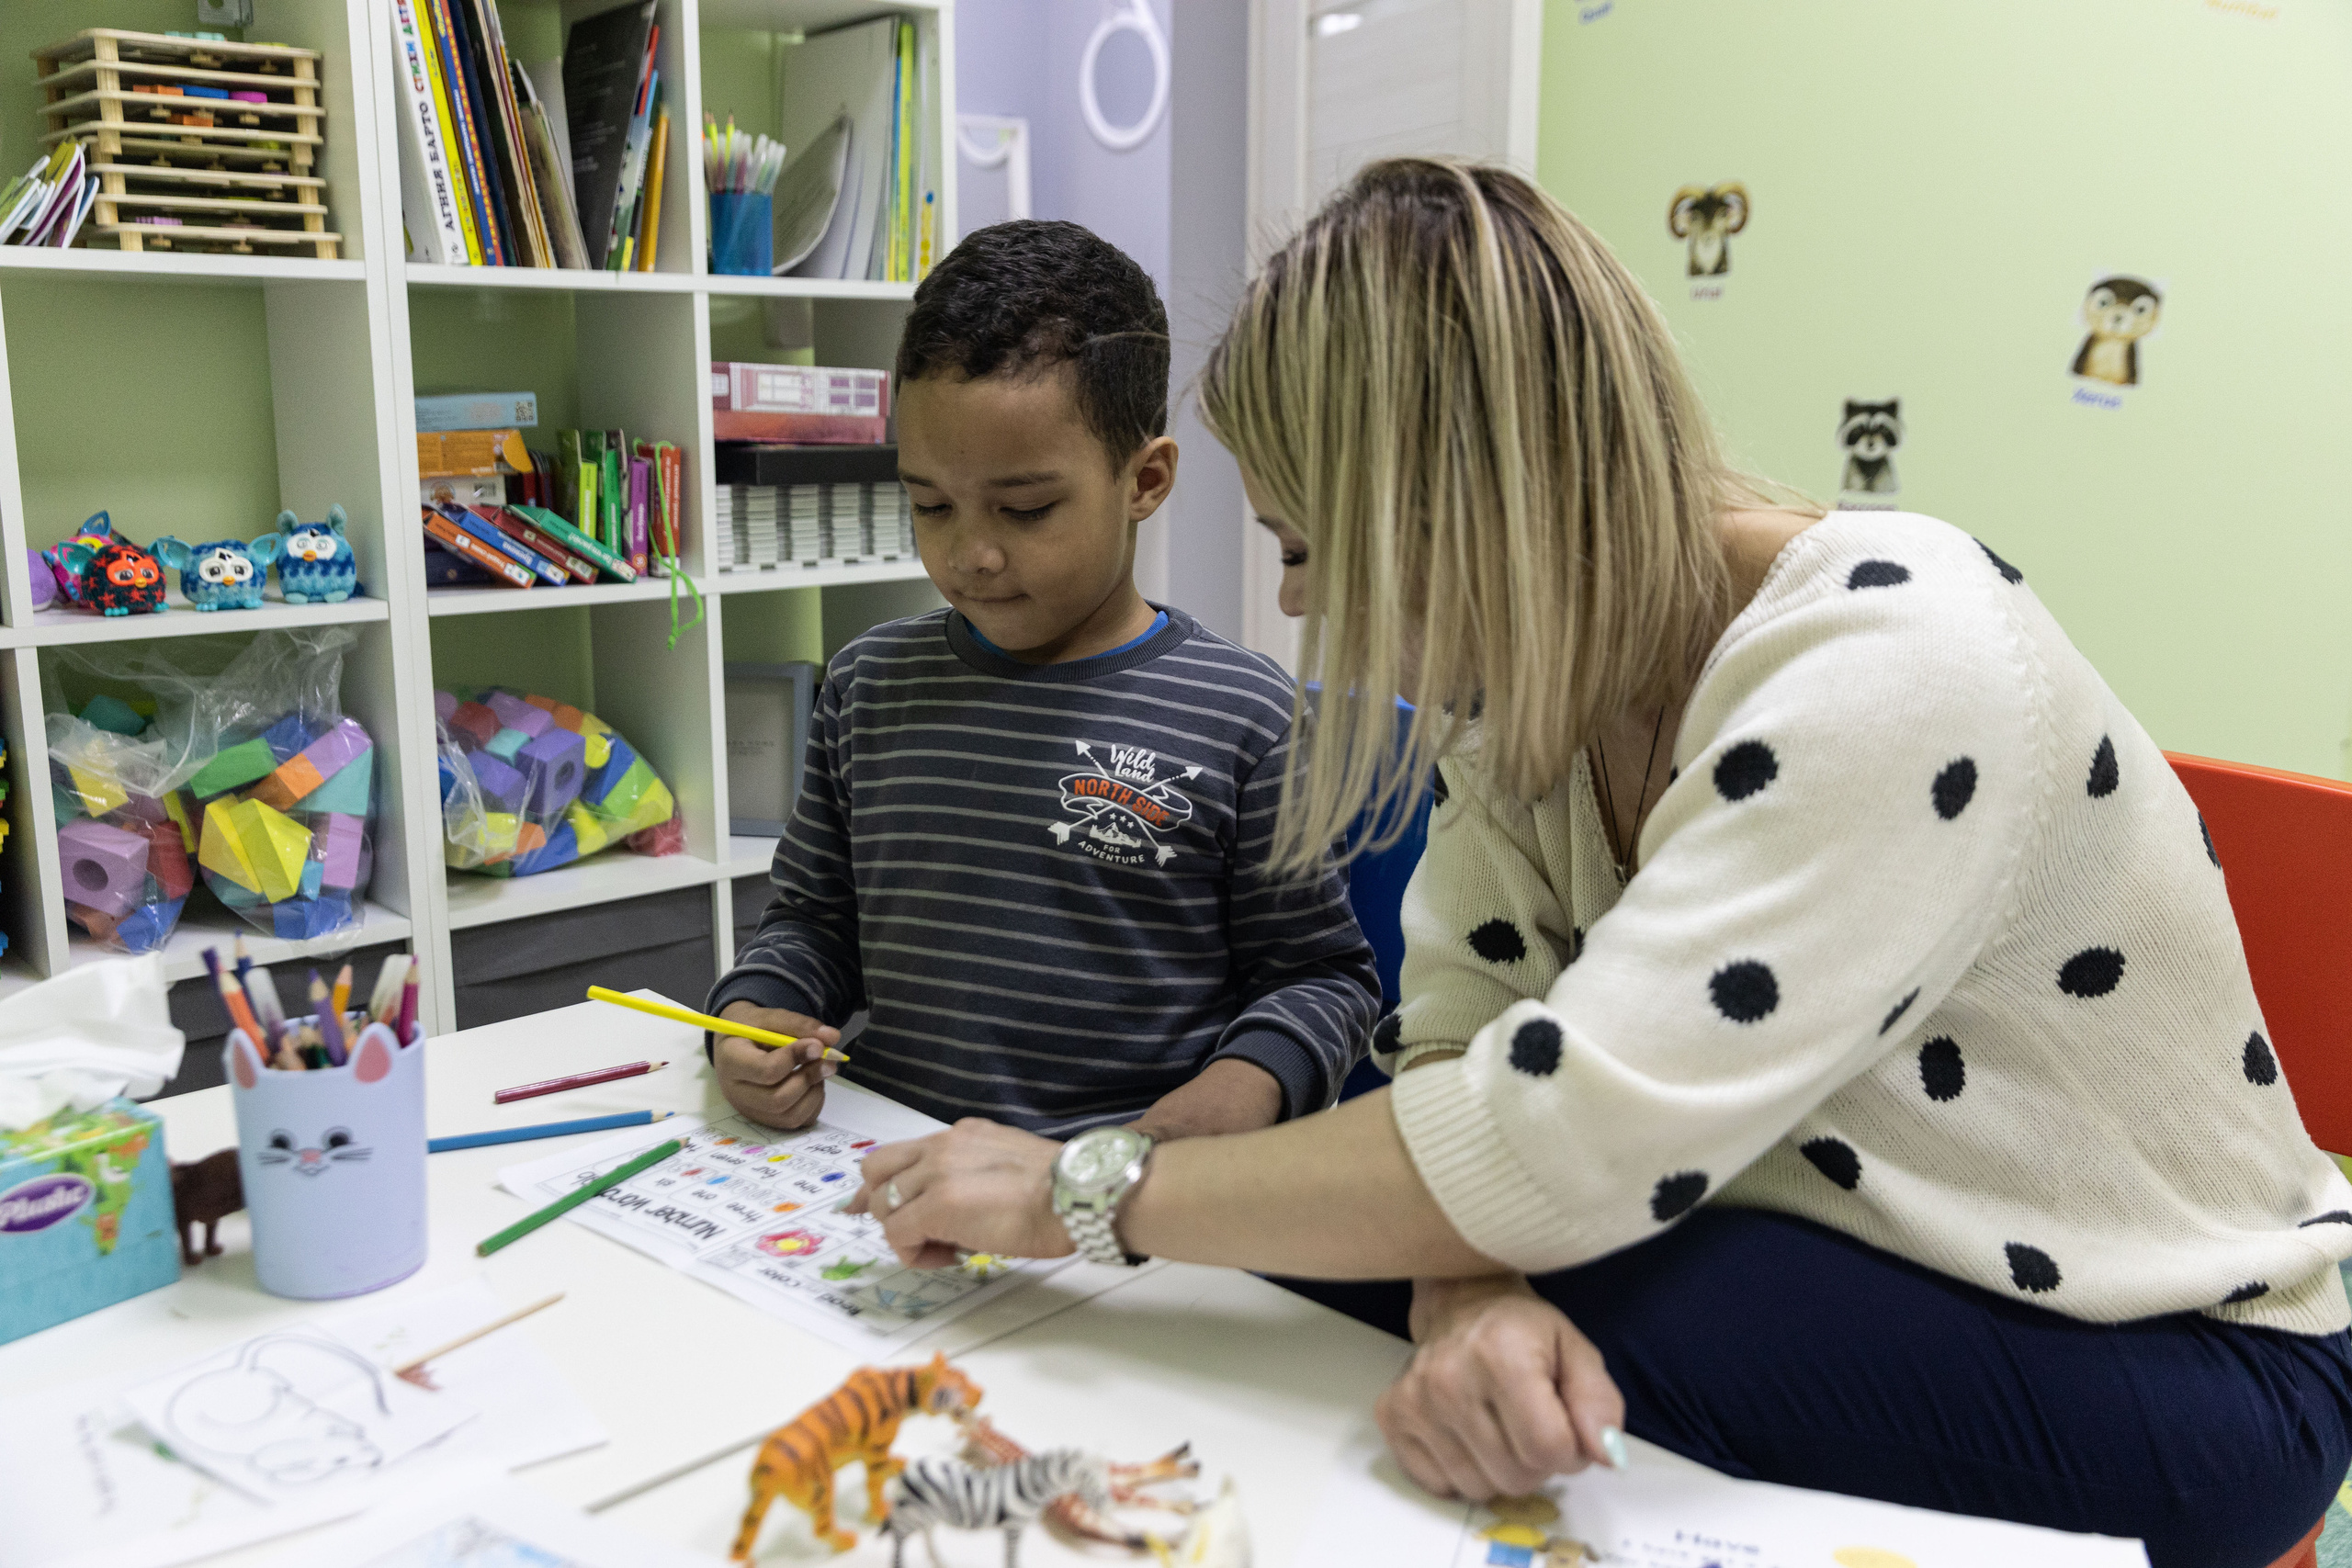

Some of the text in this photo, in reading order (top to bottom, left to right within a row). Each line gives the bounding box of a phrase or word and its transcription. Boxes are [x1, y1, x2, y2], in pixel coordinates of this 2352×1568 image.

[405, 40, 424, 93] СТИХИ
[419, 102, 440, 162] БАРТО
[434, 168, 455, 231] АГНИЯ
[1110, 744, 1156, 770] Wild
[1114, 761, 1156, 783] Land
[1074, 778, 1170, 827] NORTH SIDE
[1078, 840, 1146, 863] ADVENTURE
[1102, 844, 1121, 854] FOR
[710, 1152, 746, 1165] seven
[805, 1143, 842, 1156] eight
[752, 1166, 781, 1179] four
[692, 1189, 718, 1201] one
[794, 1179, 823, 1194] nine
[644, 1204, 728, 1240] Number
[727, 1201, 764, 1224] three
[757, 1268, 862, 1316] Read Color
